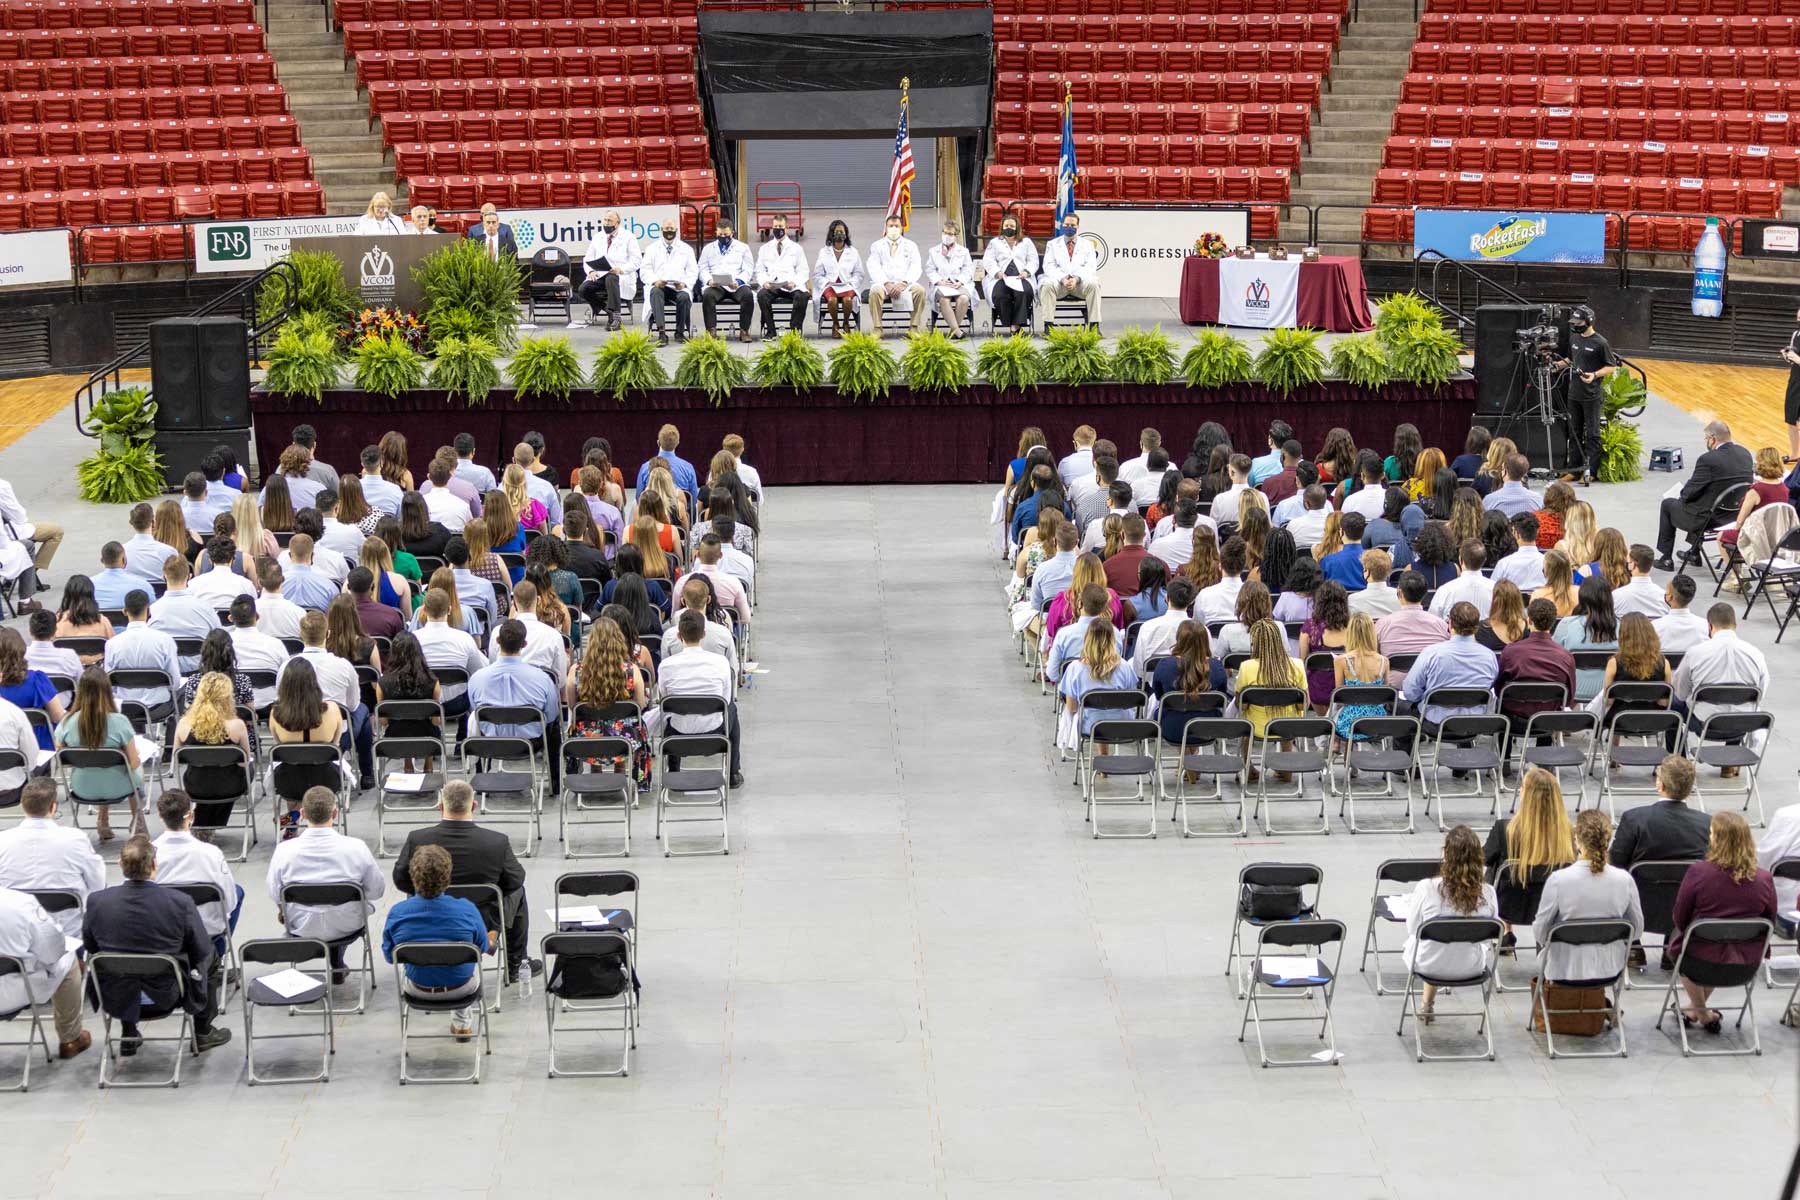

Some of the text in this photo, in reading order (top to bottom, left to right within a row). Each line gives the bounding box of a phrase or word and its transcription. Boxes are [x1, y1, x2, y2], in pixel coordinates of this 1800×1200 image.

[253, 222, 359, 237] FIRST NATIONAL BAN
[624, 216, 661, 240] ibe
[1471, 217, 1547, 252] RocketFast!
[264, 244, 279, 252] The
[1114, 247, 1195, 259] PROGRESSIV
[362, 276, 393, 285] VCOM
[1695, 278, 1722, 288] DASANI
[1247, 300, 1269, 308] VCOM
